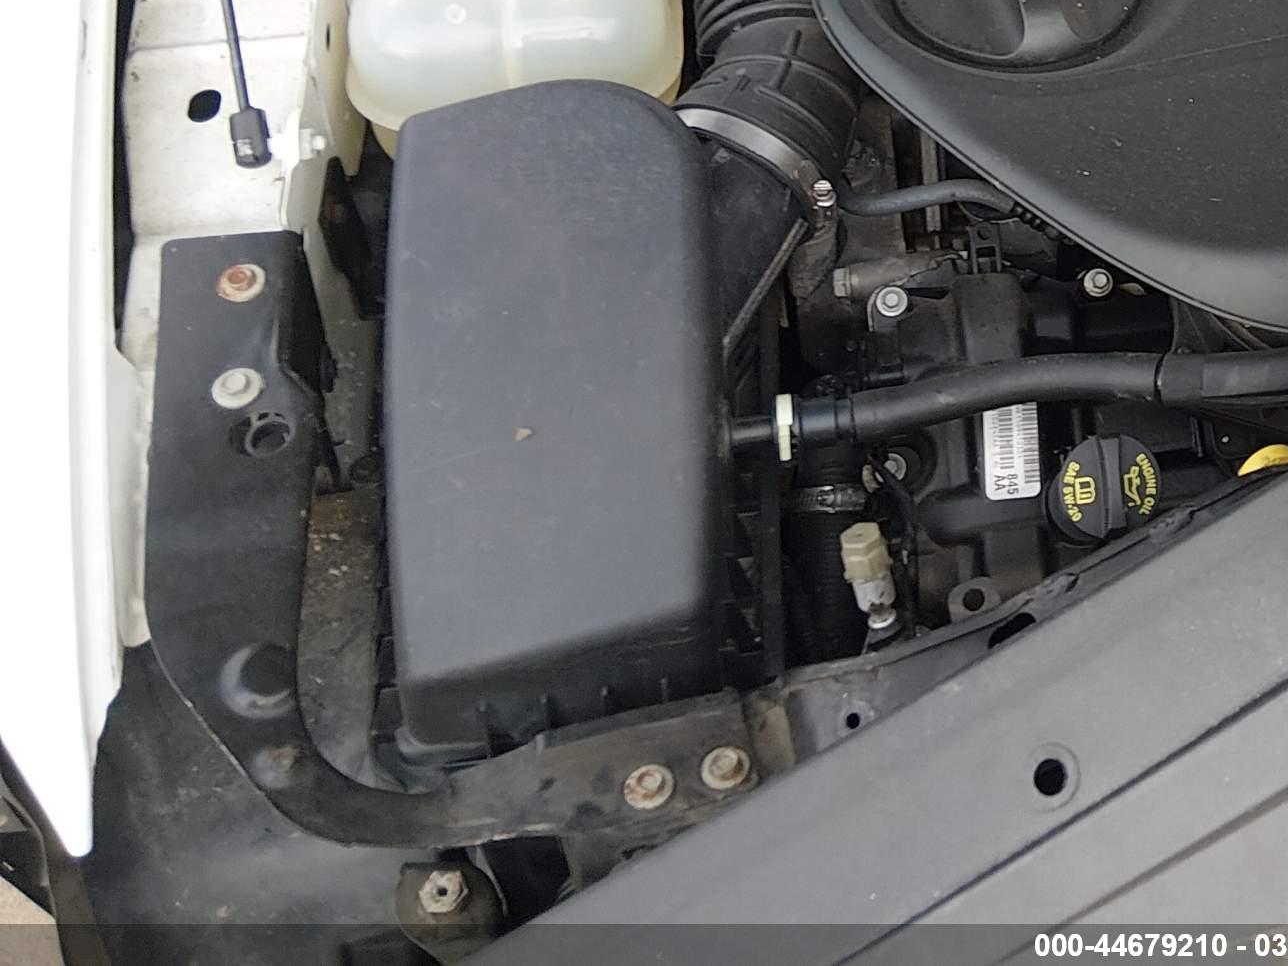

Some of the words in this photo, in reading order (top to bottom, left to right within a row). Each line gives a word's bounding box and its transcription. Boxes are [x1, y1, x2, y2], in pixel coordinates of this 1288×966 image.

[994, 475, 1006, 491] AA
[1064, 461, 1080, 484] SAE
[1136, 453, 1156, 495] ENGINE
[1007, 474, 1019, 495] 845
[1139, 497, 1155, 514] OIL
